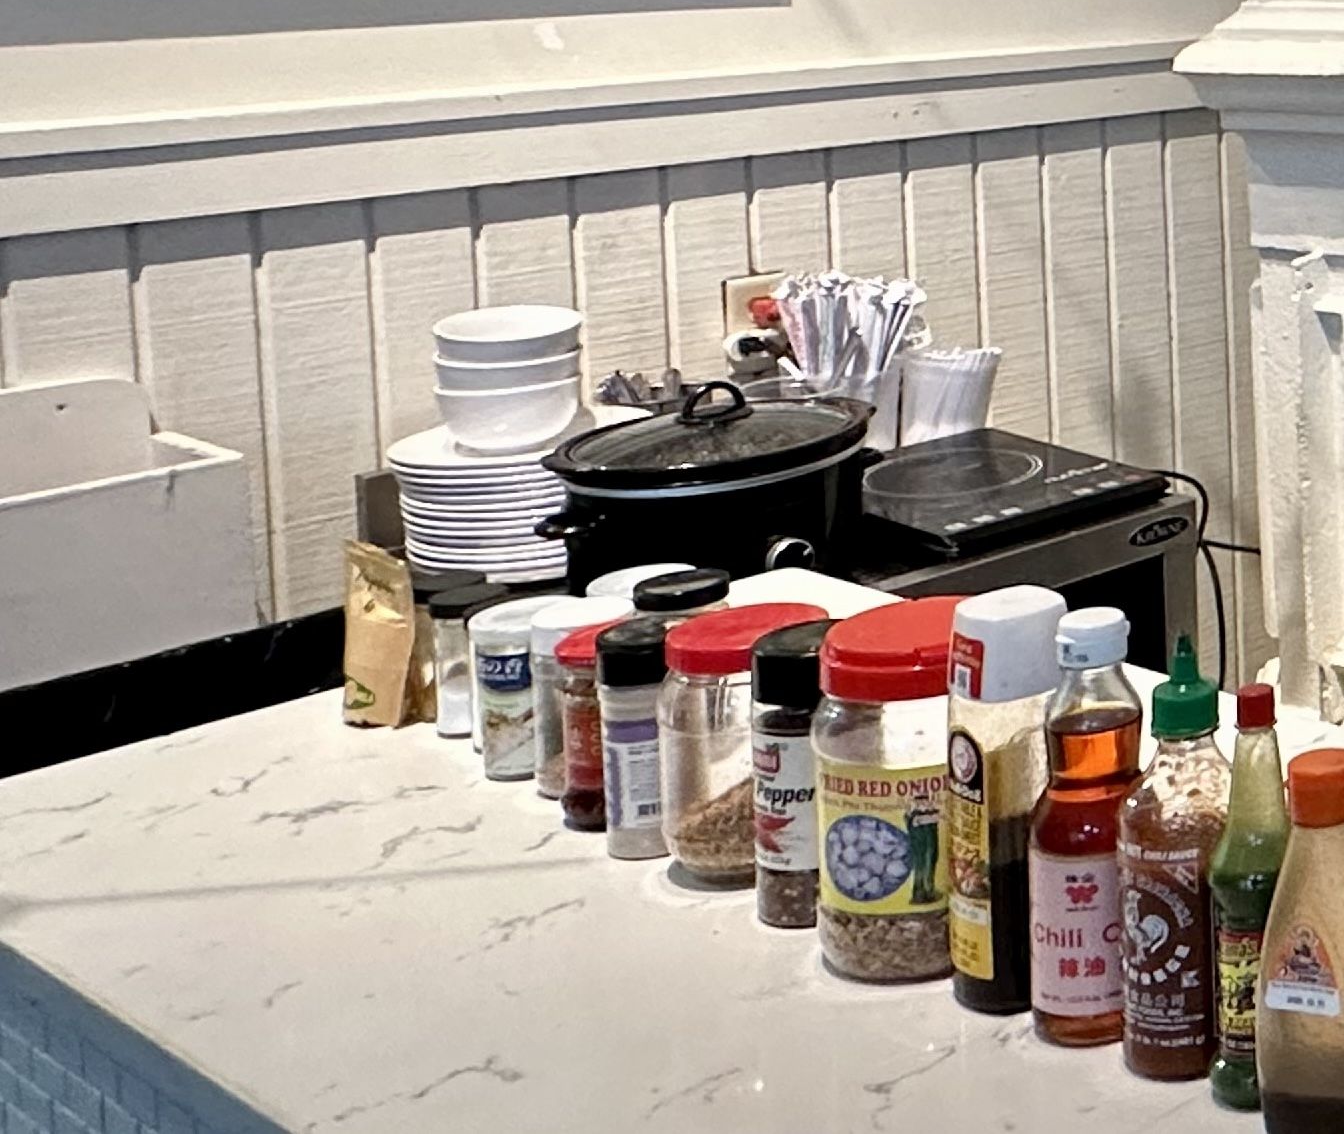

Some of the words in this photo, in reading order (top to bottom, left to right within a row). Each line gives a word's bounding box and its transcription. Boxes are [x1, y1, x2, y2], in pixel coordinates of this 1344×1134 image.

[756, 780, 817, 808] Pepper
[857, 780, 892, 798] RED
[1034, 921, 1084, 949] Chili
